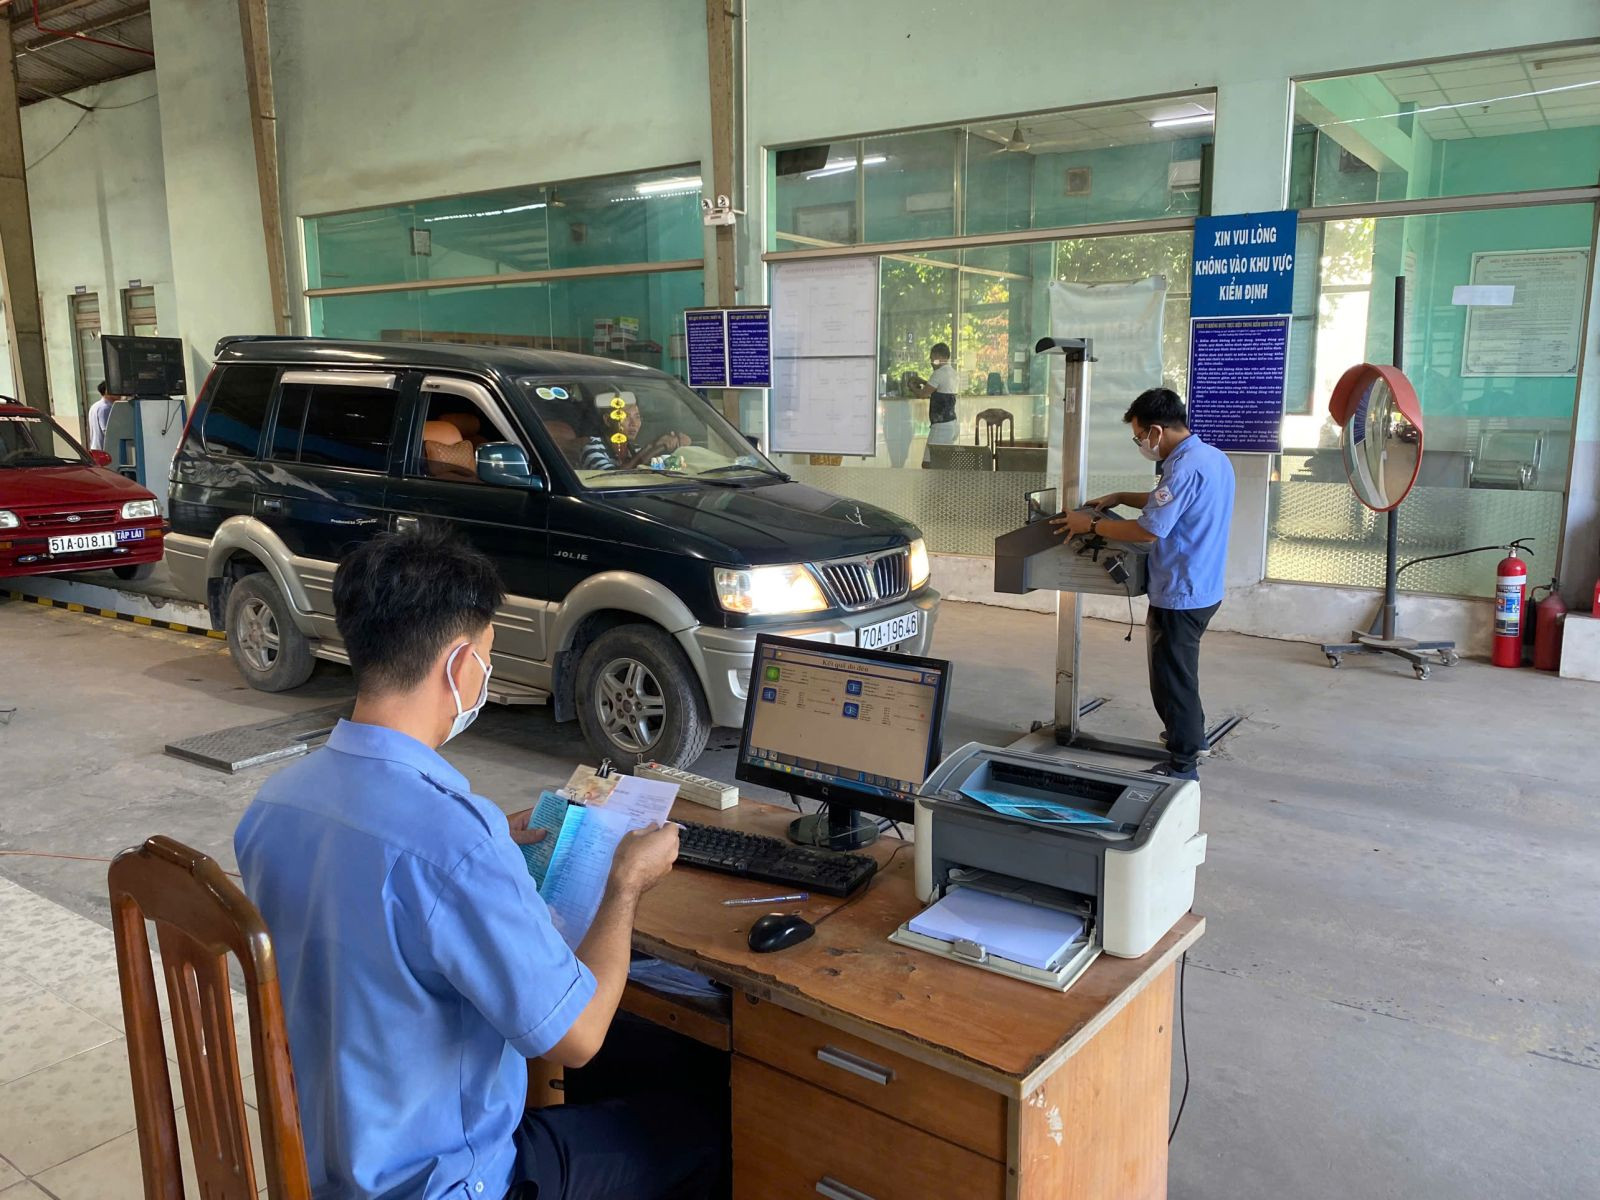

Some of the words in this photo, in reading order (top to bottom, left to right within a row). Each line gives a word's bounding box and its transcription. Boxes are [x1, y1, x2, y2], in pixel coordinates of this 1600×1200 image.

[1214, 231, 1231, 247] XIN
[1233, 229, 1249, 246] VUI
[1250, 223, 1277, 245] LÒNG
[1195, 256, 1228, 276] KHÔNG
[1229, 254, 1248, 274] VÀO
[1249, 256, 1270, 273] KHU
[1272, 253, 1293, 276] VỰC
[1219, 276, 1243, 301] KIỂM
[1244, 283, 1268, 304] ĐỊNH
[51, 535, 113, 550] 51A-018.11
[117, 531, 129, 541] TẬP
[131, 529, 141, 538] LÁI
[553, 550, 589, 561] JOLIE
[862, 614, 917, 649] 70A-196.46
